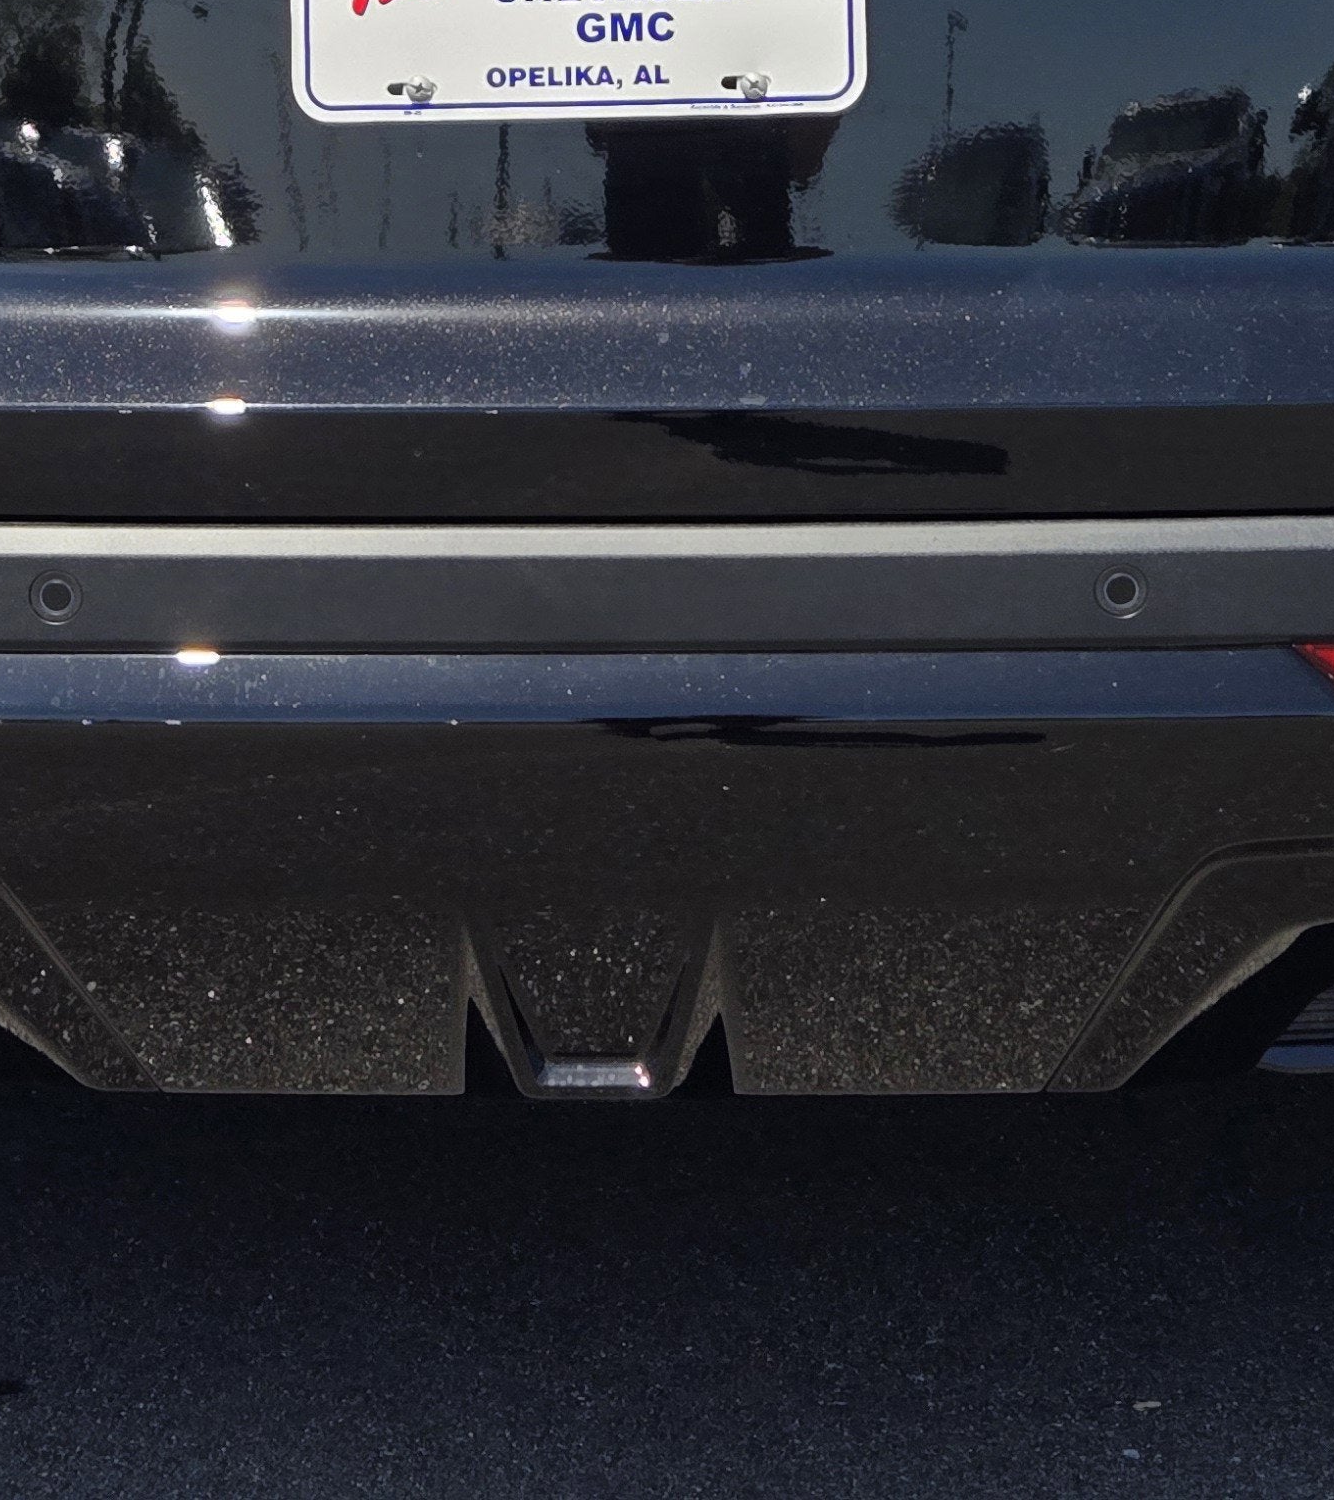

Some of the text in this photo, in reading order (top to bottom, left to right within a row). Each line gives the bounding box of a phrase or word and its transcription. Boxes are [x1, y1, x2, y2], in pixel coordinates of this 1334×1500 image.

[576, 11, 675, 42] GMC
[486, 64, 670, 89] OPELIKA, AL
